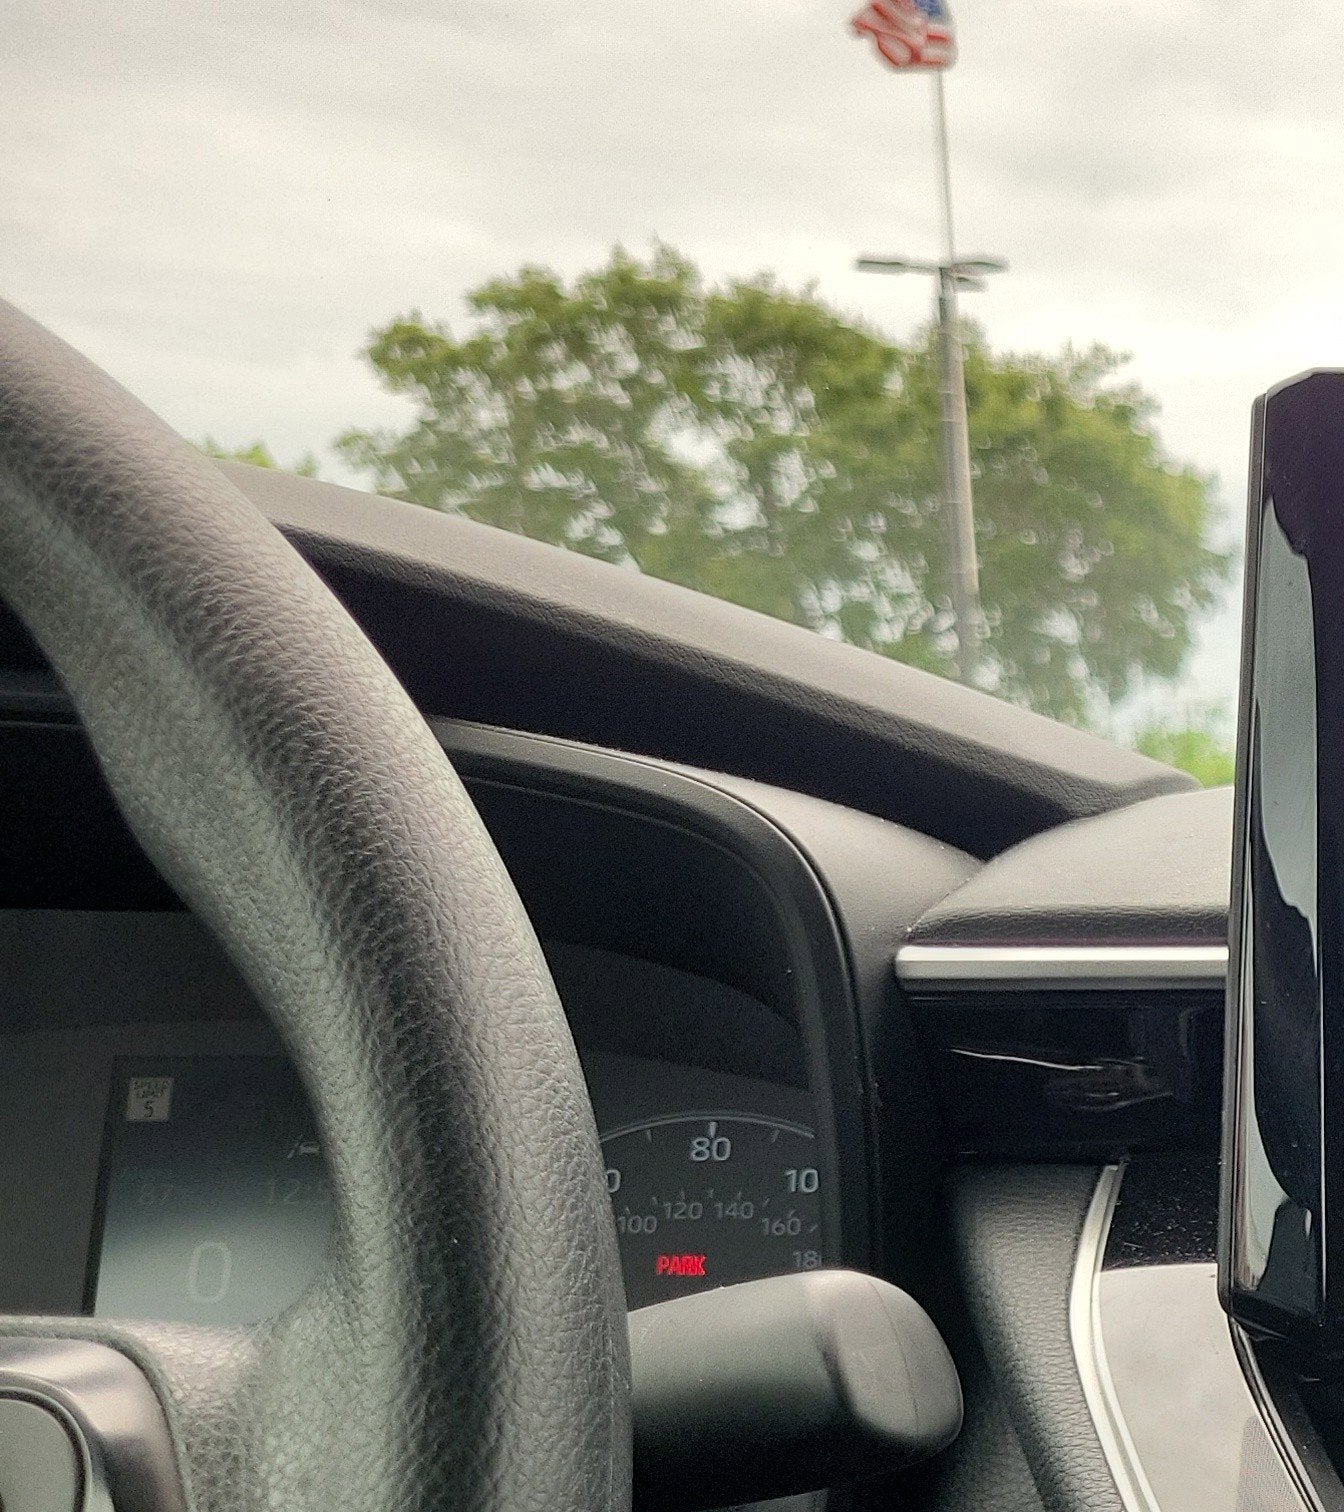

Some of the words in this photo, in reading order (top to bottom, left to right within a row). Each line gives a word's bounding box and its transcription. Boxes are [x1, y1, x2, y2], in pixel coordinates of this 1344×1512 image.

[691, 1137, 731, 1161] 80
[605, 1169, 621, 1193] 0
[785, 1168, 819, 1192] 10
[664, 1201, 703, 1219] 120
[715, 1202, 754, 1220] 140
[618, 1216, 658, 1233] 100
[761, 1218, 800, 1236] 160
[657, 1253, 706, 1276] PARK
